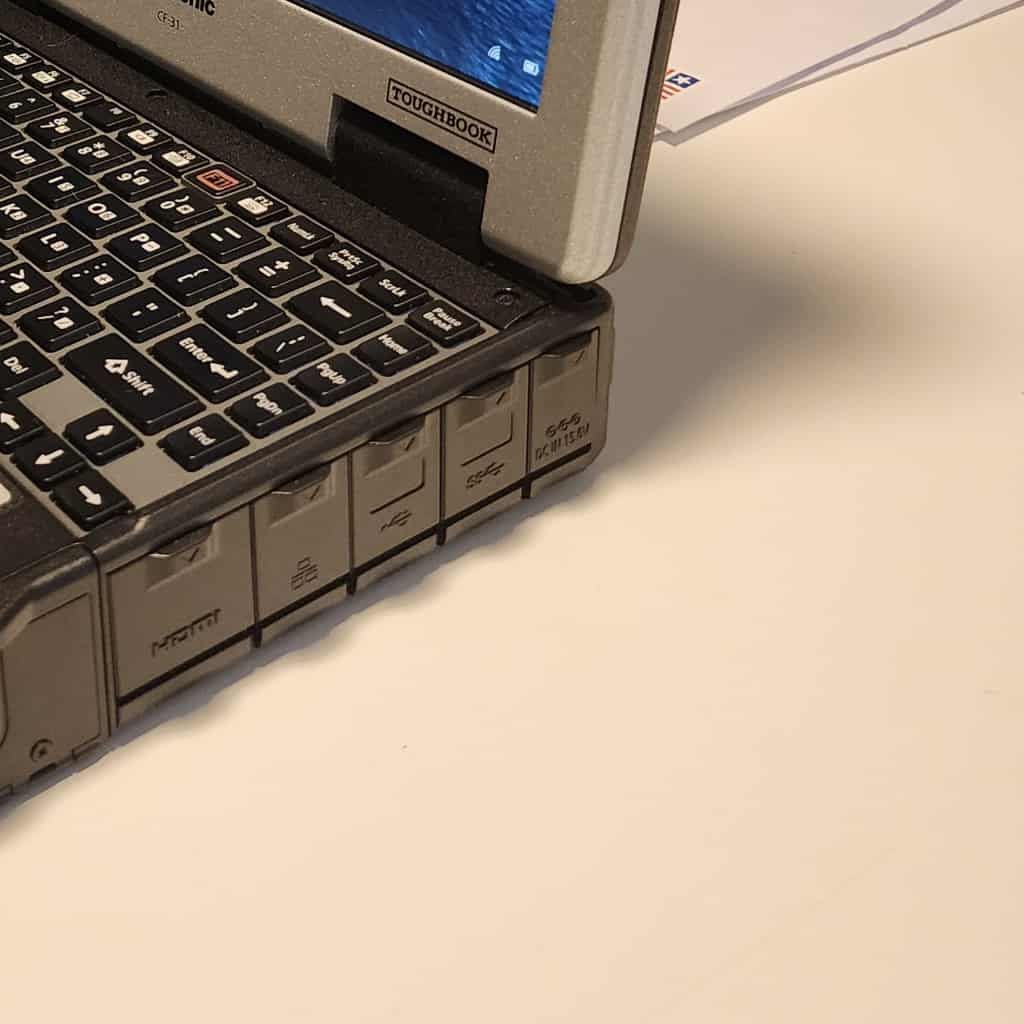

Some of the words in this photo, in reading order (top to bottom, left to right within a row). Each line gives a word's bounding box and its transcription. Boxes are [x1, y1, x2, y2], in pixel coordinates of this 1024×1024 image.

[392, 85, 493, 146] TOUGHBOOK
[423, 312, 453, 331] Break
[432, 307, 462, 326] Pause
[178, 337, 213, 363] Enter
[378, 334, 408, 355] Home
[3, 356, 29, 375] Del
[317, 362, 346, 385] PgUp
[122, 371, 155, 396] Shift
[253, 392, 282, 415] PgDn
[189, 426, 216, 446] End
